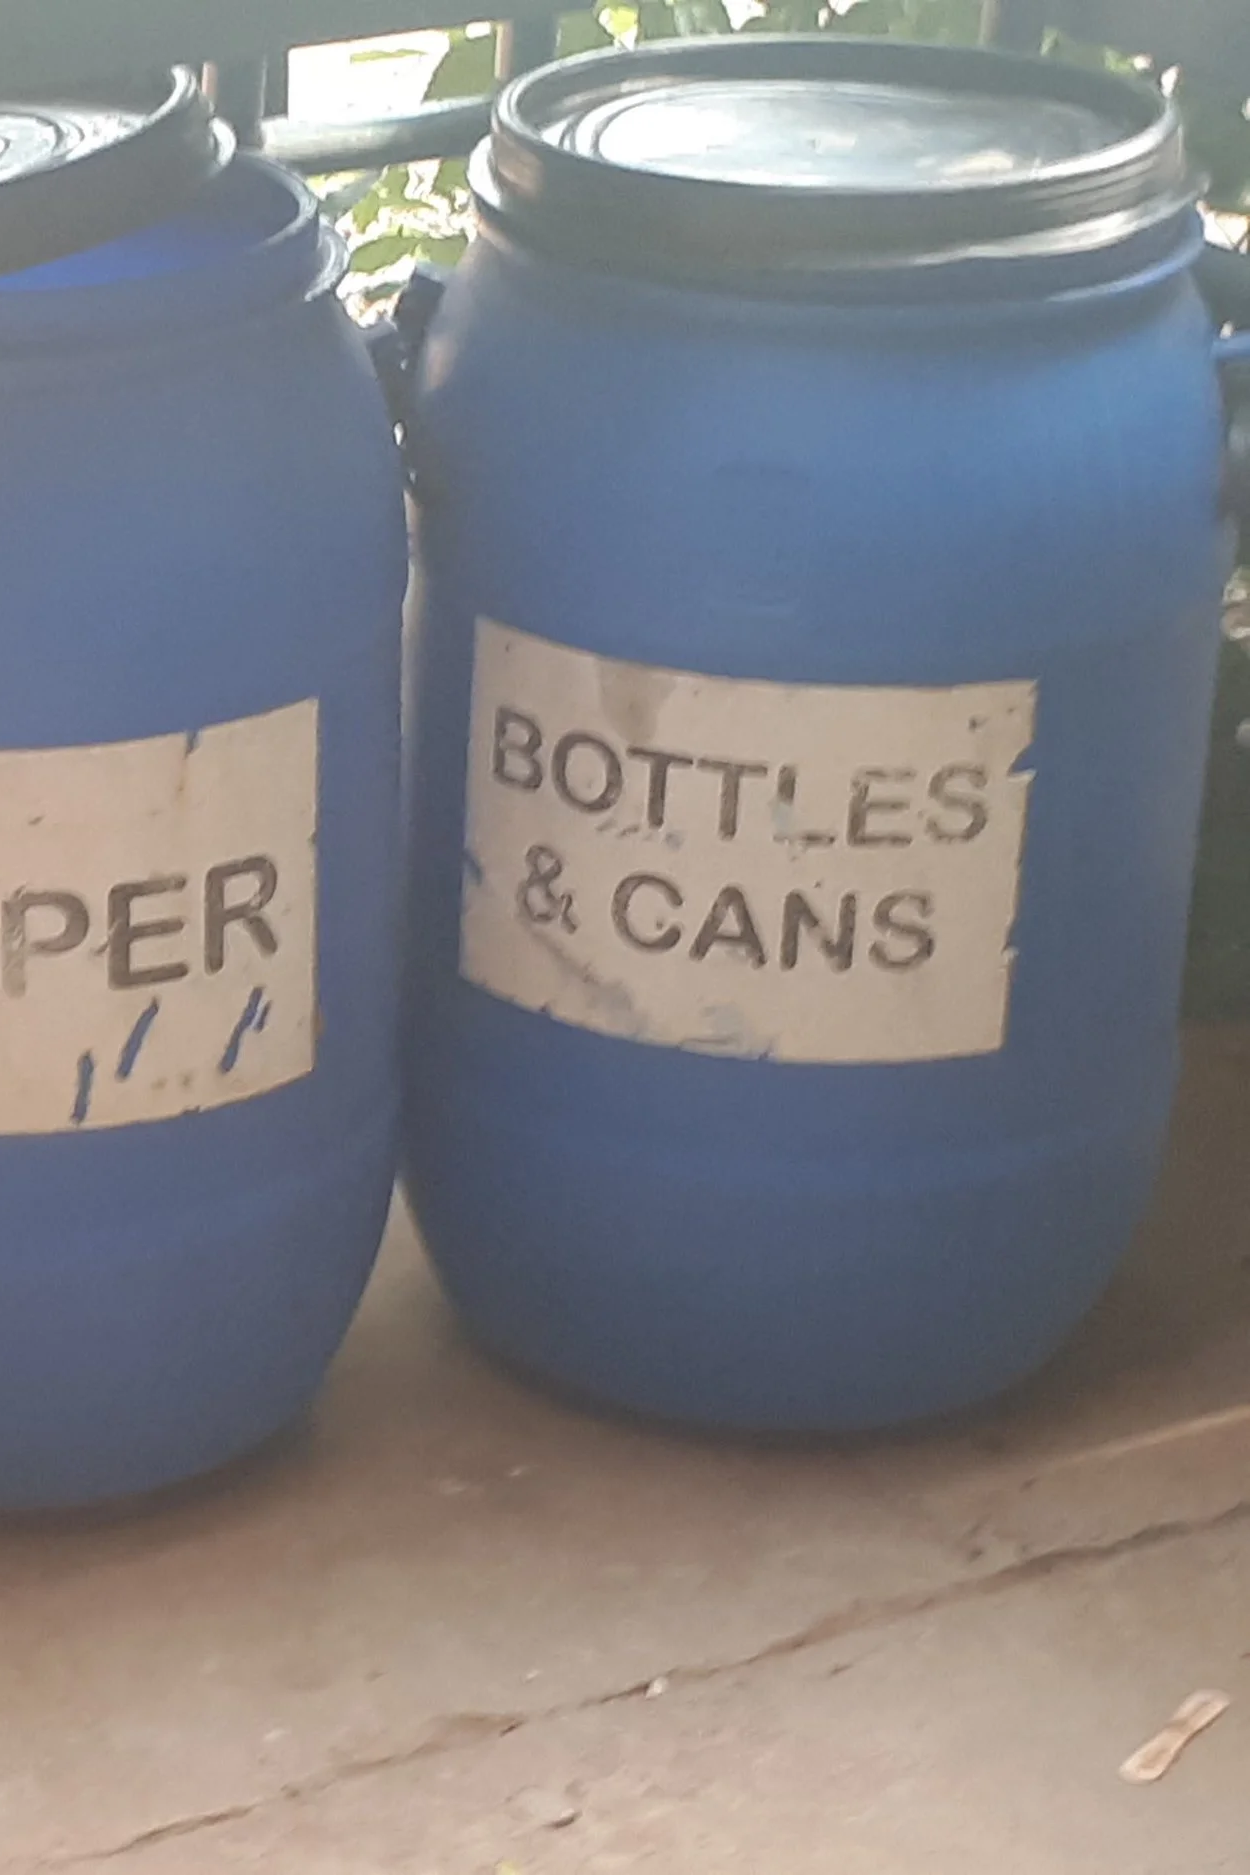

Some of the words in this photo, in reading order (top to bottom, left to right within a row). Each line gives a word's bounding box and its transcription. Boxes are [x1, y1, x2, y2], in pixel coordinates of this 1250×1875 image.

[492, 704, 990, 848] BOTTLES
[518, 845, 580, 934] &
[611, 874, 937, 972] CANS
